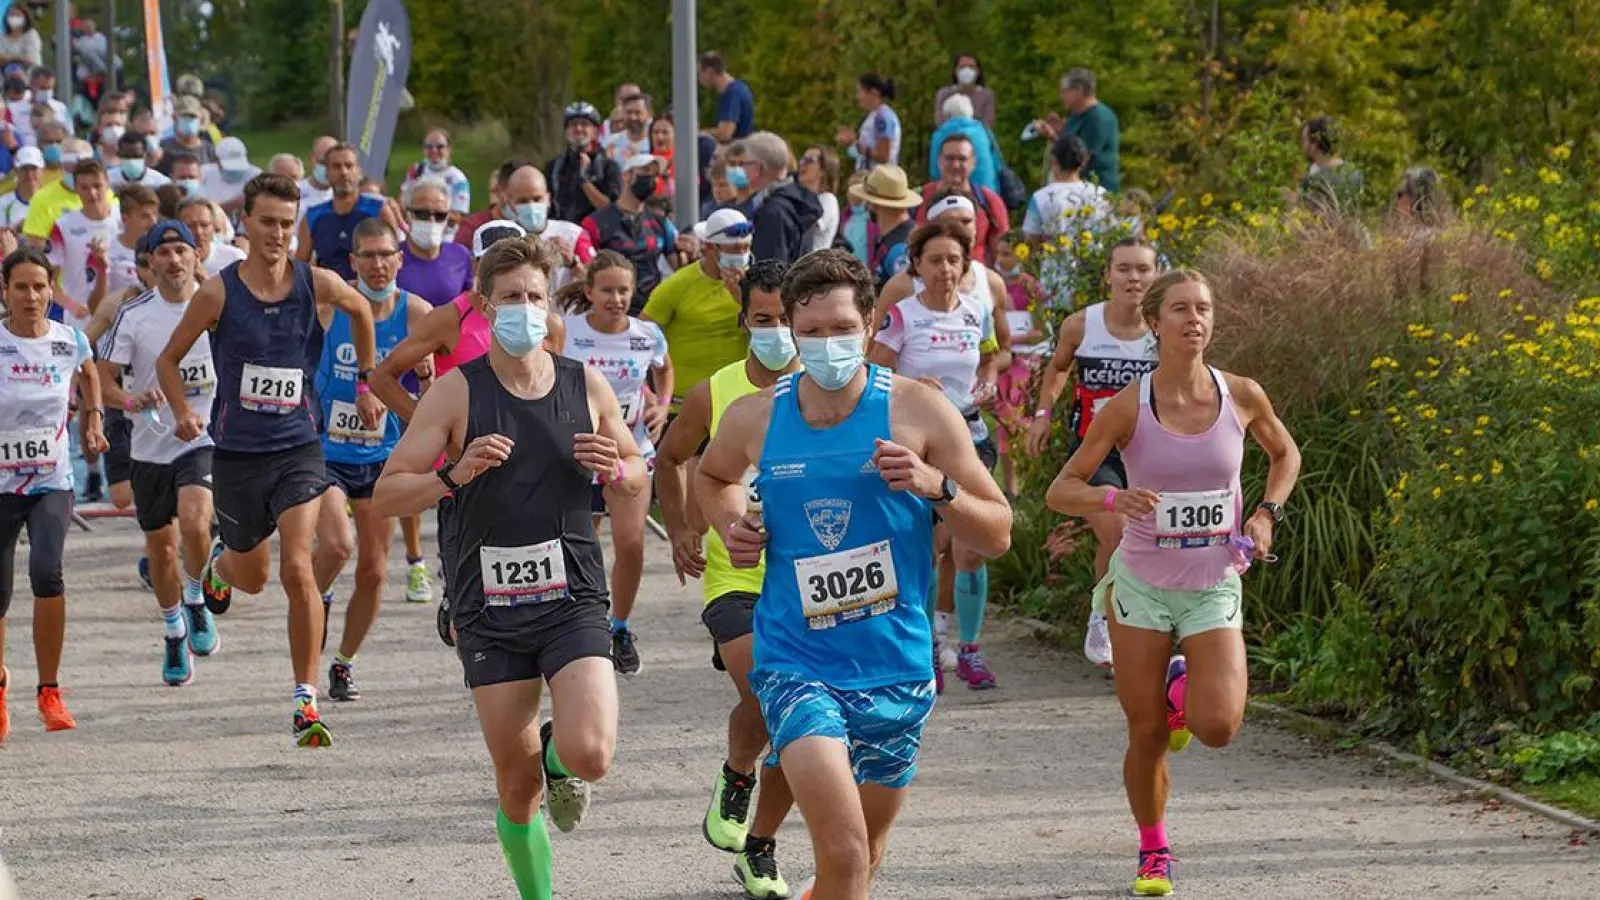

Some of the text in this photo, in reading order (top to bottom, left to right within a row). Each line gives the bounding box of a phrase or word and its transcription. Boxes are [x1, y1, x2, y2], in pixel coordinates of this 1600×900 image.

[1100, 359, 1151, 371] TEAM
[250, 377, 296, 398] 1218
[336, 412, 369, 431] 30
[2, 440, 50, 460] 1164
[1166, 504, 1224, 528] 1306
[491, 557, 552, 584] 1231
[808, 561, 885, 603] 3026
